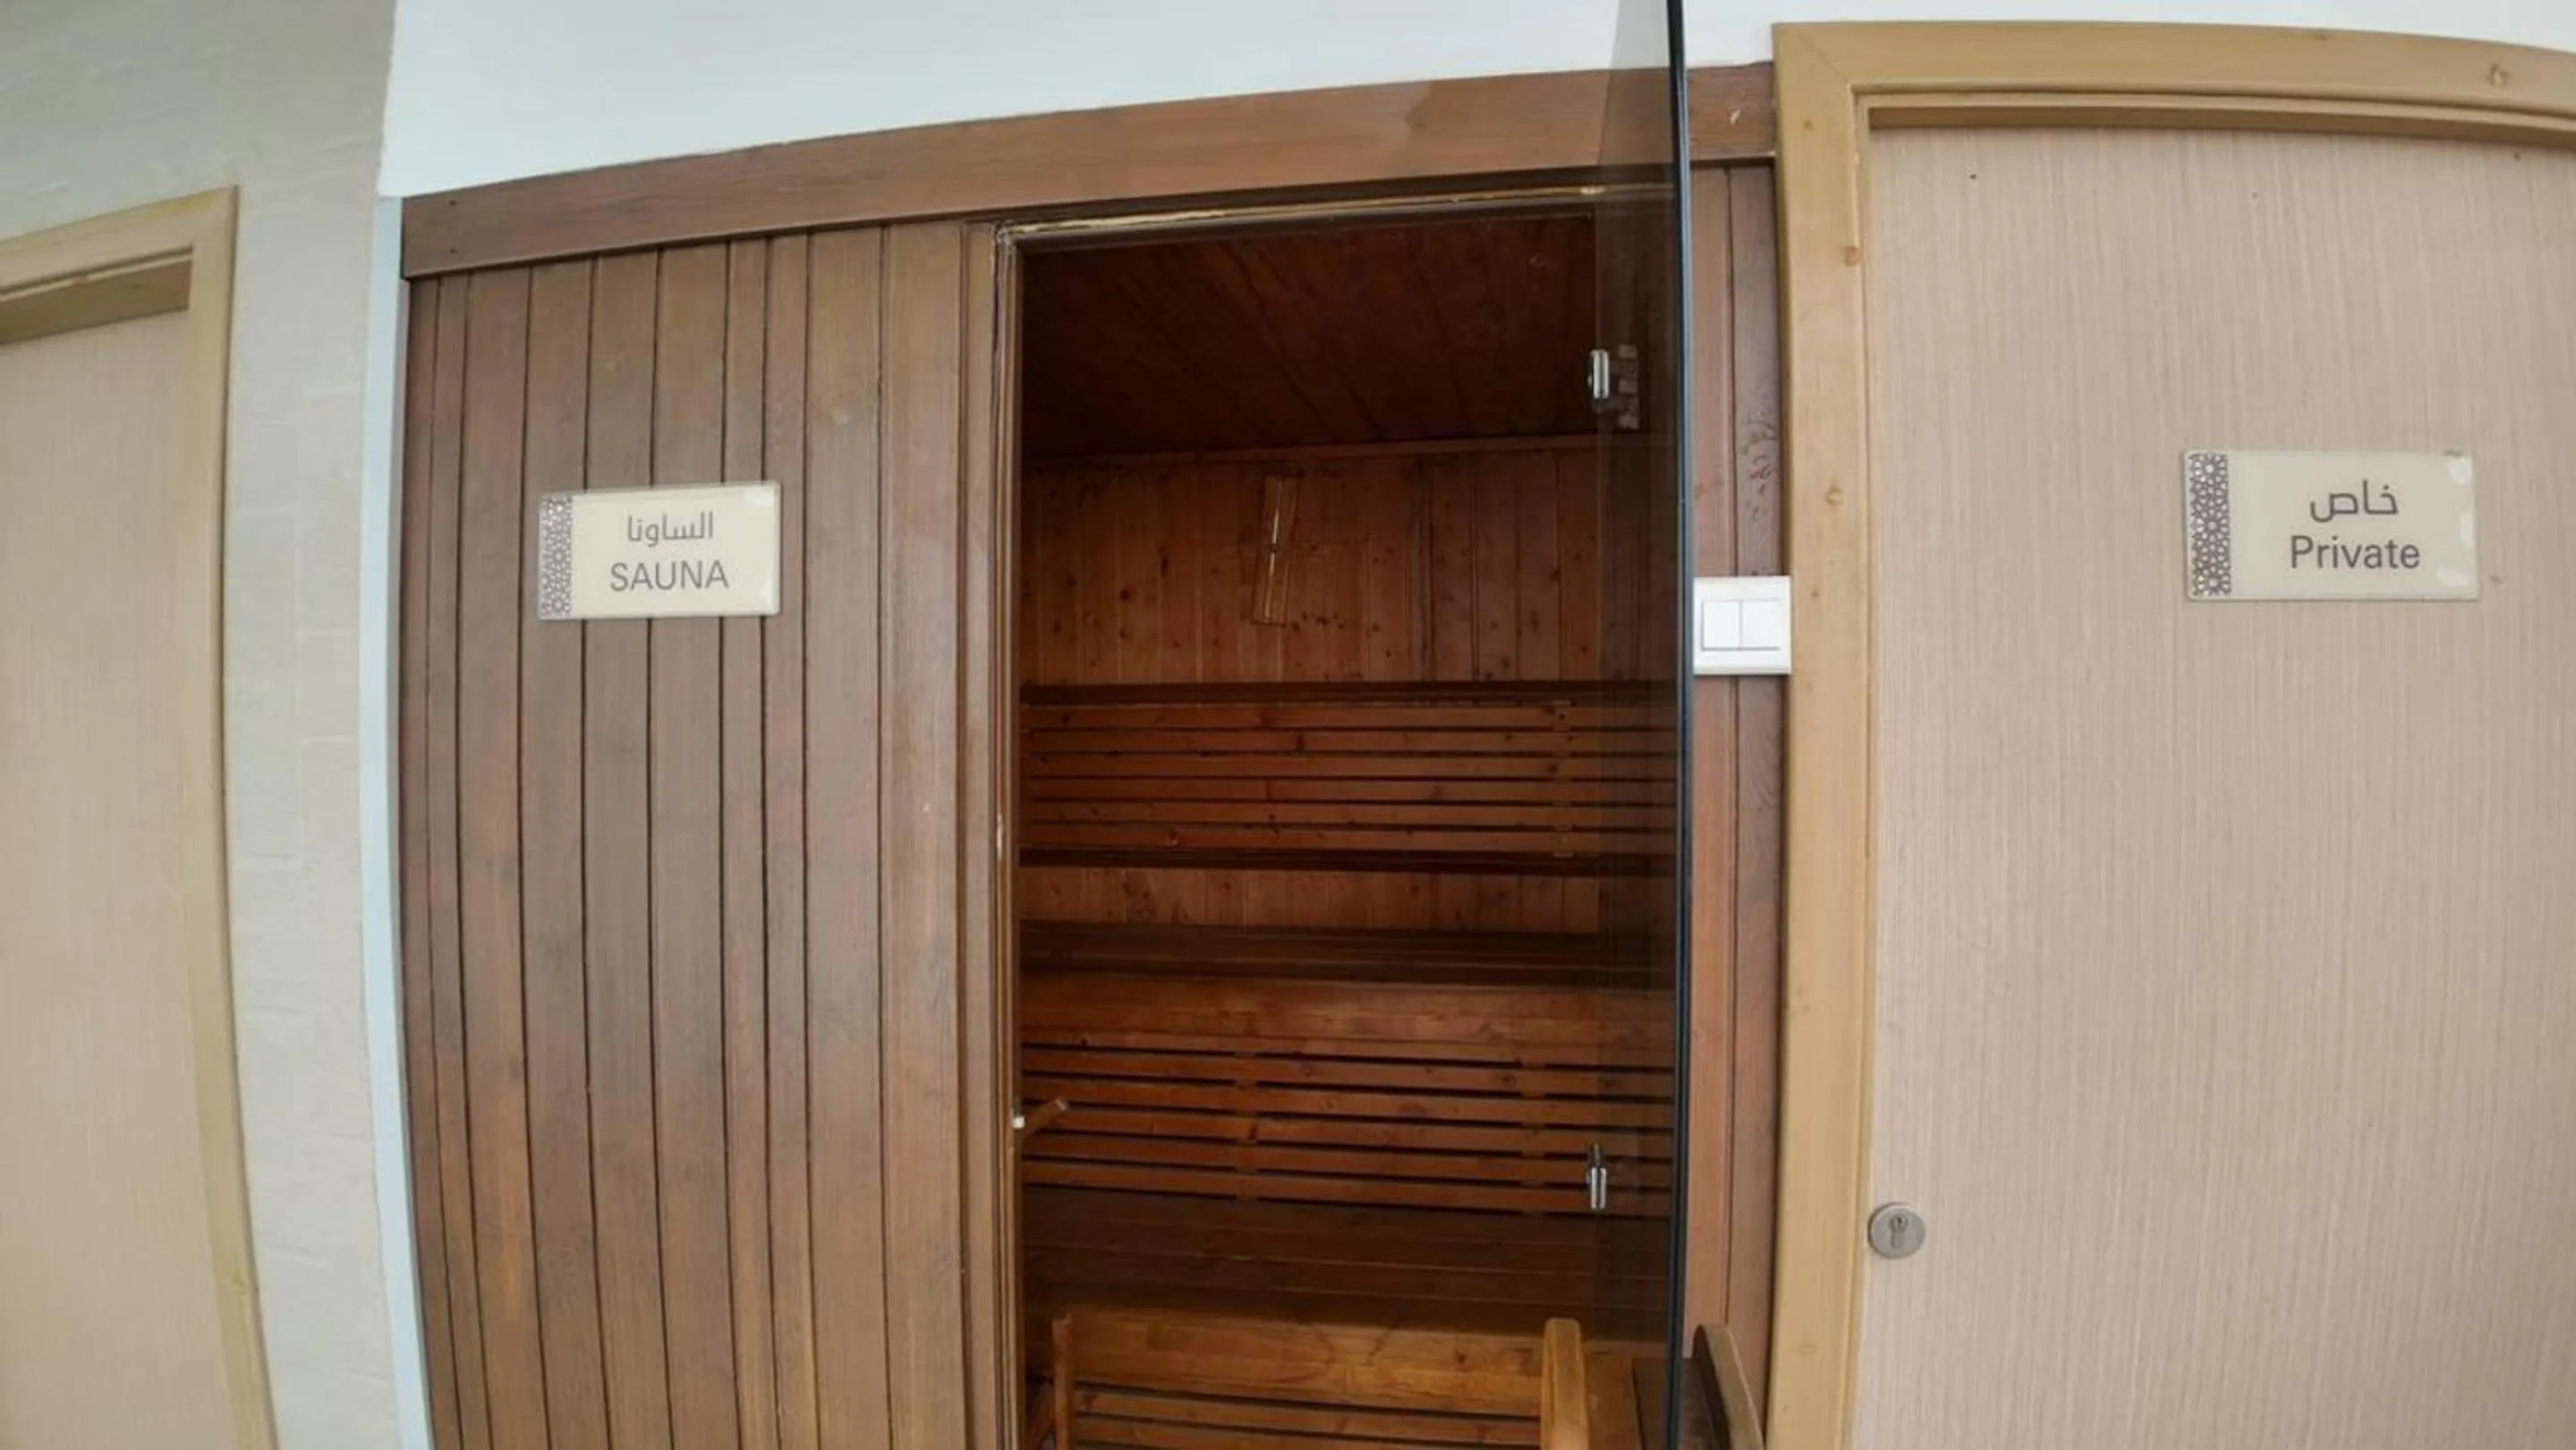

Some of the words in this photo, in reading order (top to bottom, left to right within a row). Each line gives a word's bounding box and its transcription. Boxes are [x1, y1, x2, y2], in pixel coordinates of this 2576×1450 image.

[2309, 478, 2399, 523] خاص
[626, 510, 714, 548] الساونا
[2290, 534, 2420, 569] Private
[609, 559, 730, 593] SAUNA
